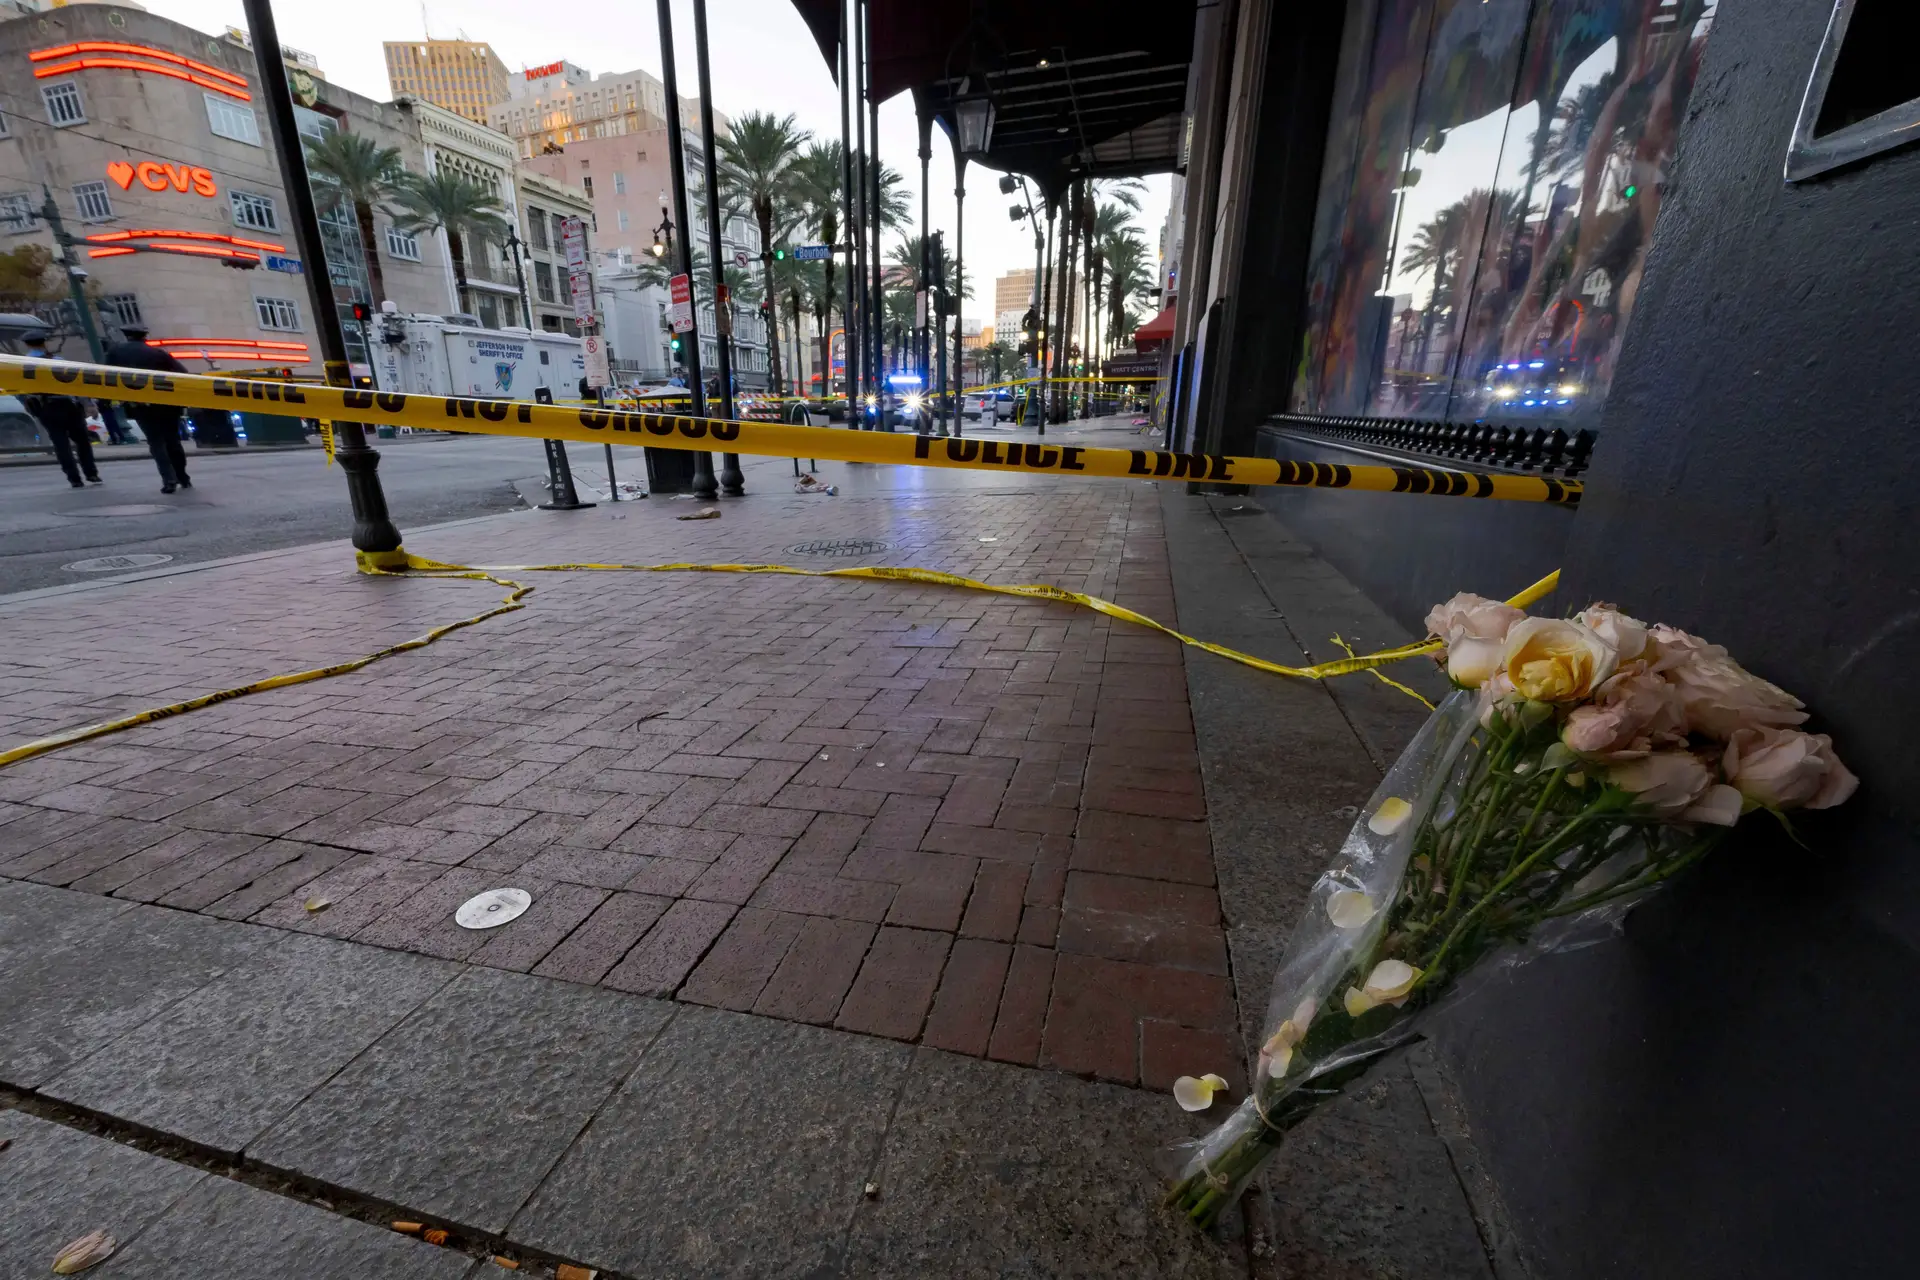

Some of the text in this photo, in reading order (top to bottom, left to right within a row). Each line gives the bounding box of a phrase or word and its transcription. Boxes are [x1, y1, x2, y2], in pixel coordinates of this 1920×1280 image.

[137, 161, 217, 197] CVS
[799, 247, 828, 259] Bourbon
[277, 258, 300, 273] Canal
[476, 341, 524, 352] JEFFERSON PARISH
[479, 349, 523, 360] SHERIFF'S OFFICE
[915, 436, 1085, 470] POLICE
[1129, 450, 1234, 480] LINE
